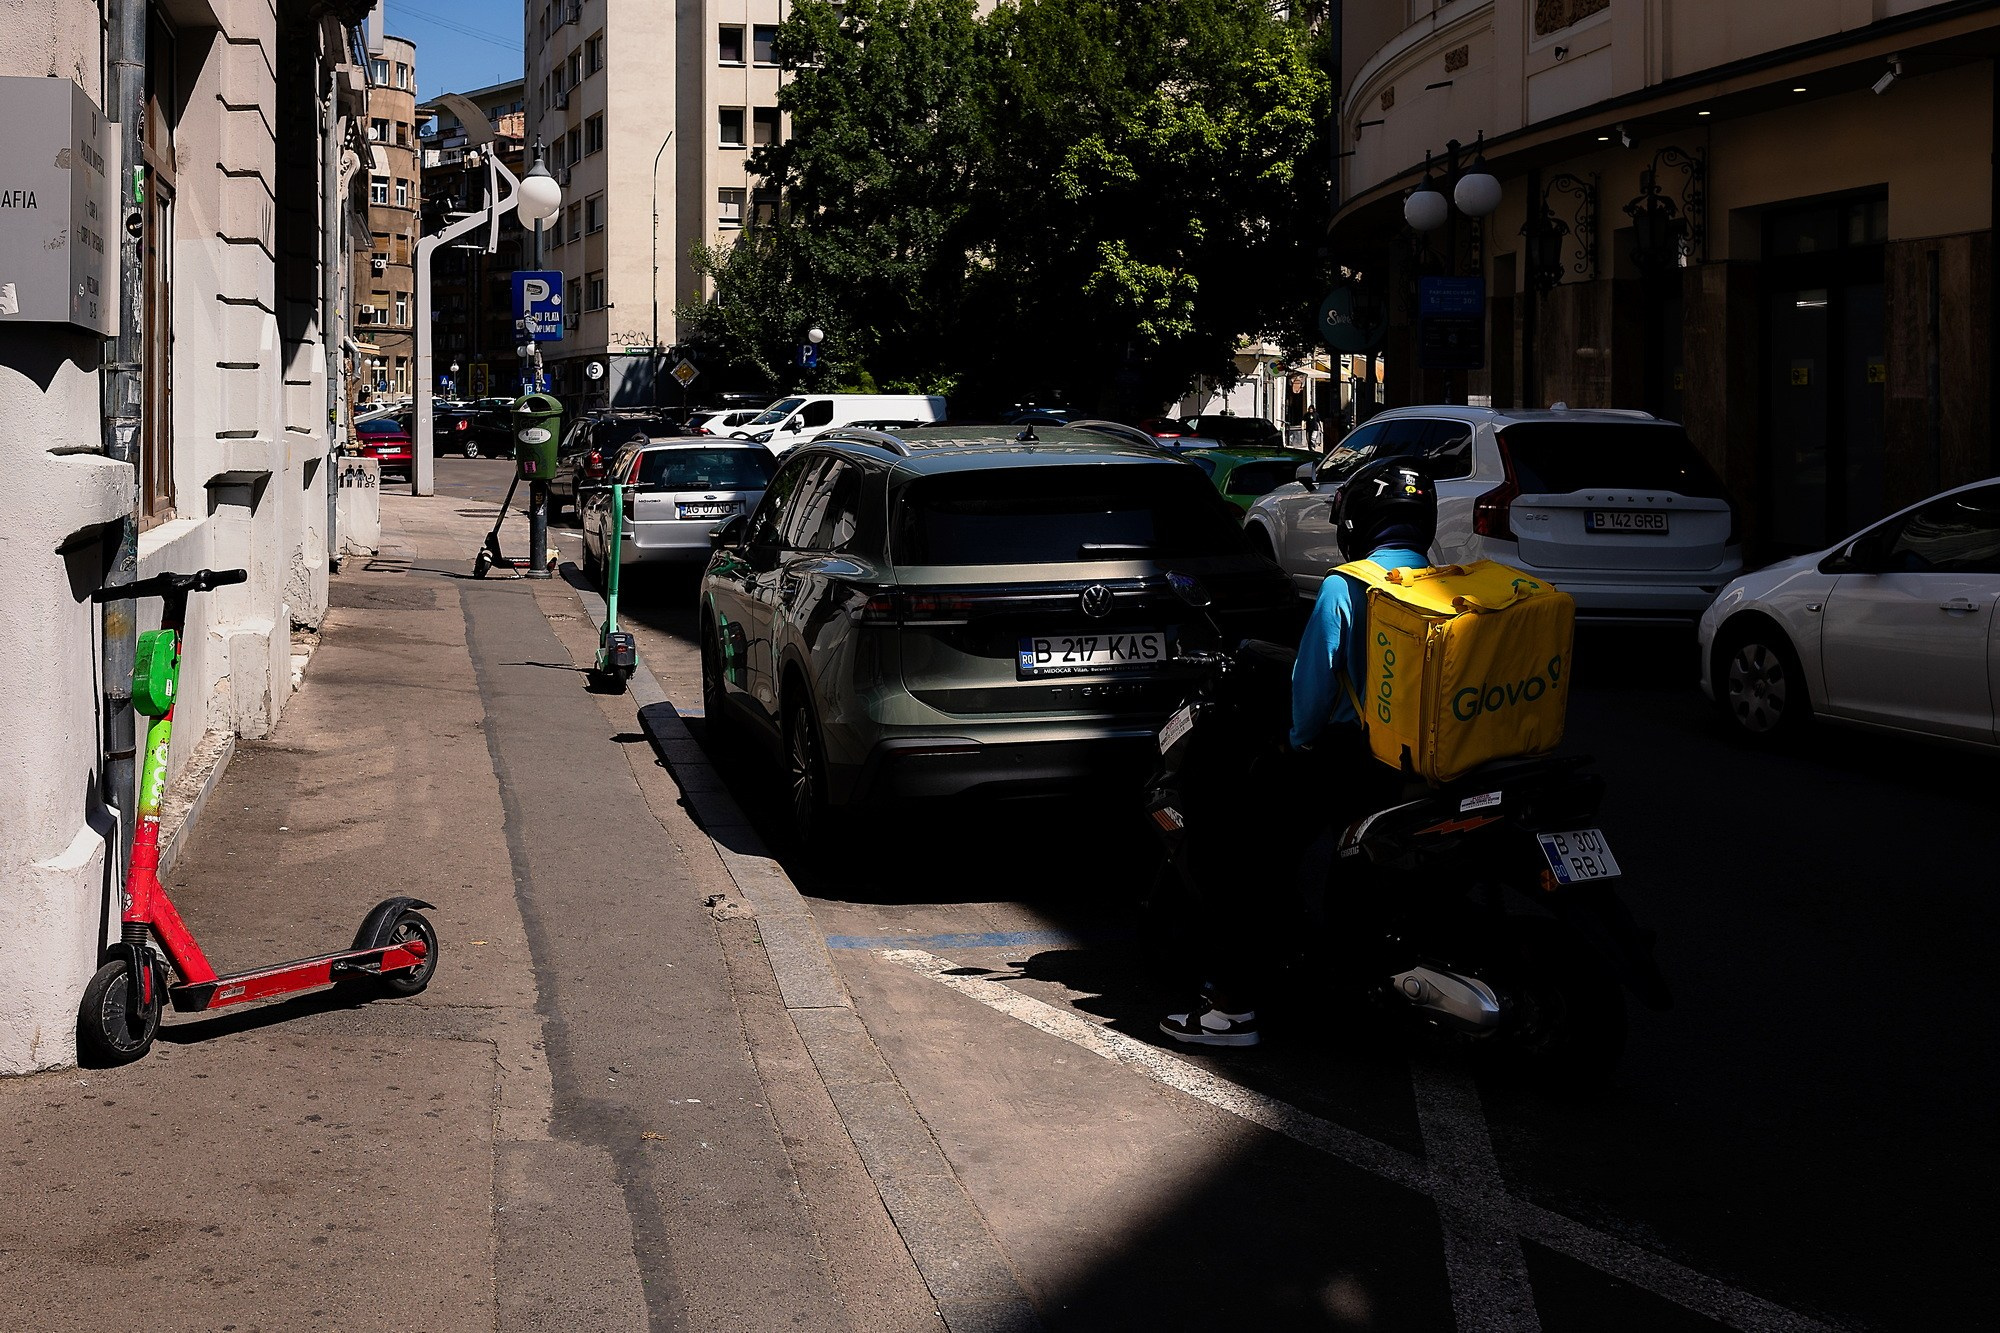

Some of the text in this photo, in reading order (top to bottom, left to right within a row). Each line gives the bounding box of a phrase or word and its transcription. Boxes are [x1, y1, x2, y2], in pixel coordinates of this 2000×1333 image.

[1, 190, 37, 209] AFIA
[591, 364, 599, 375] 5
[1585, 495, 1673, 503] VOLVO
[686, 503, 700, 514] AG
[703, 503, 715, 514] 07
[716, 503, 739, 513] NOF
[1595, 513, 1664, 529] B 142 GRB
[1034, 635, 1159, 663] B 217 KAS
[1022, 655, 1033, 664] RO
[1377, 648, 1396, 724] Glovo
[1452, 676, 1546, 721] Glovo
[1553, 833, 1569, 855] B
[1555, 864, 1568, 878] RO
[1570, 856, 1608, 879] RBJ
